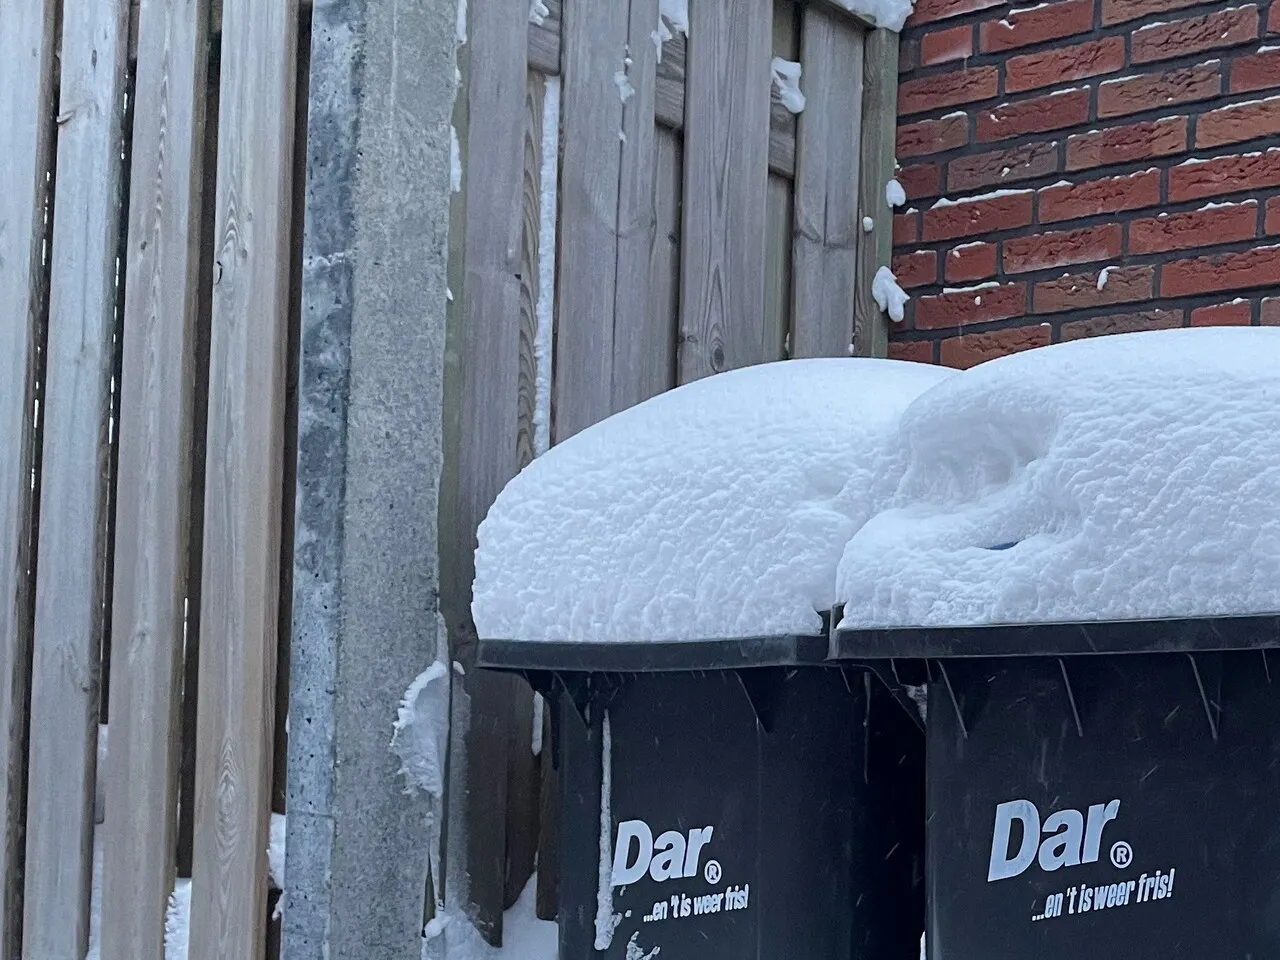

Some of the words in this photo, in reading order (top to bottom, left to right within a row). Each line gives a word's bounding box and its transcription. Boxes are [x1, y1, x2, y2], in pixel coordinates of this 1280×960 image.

[680, 893, 692, 917] is
[693, 893, 724, 915] weer
[1077, 883, 1093, 913] is
[1093, 880, 1135, 911] weer
[1136, 868, 1175, 903] fris!
